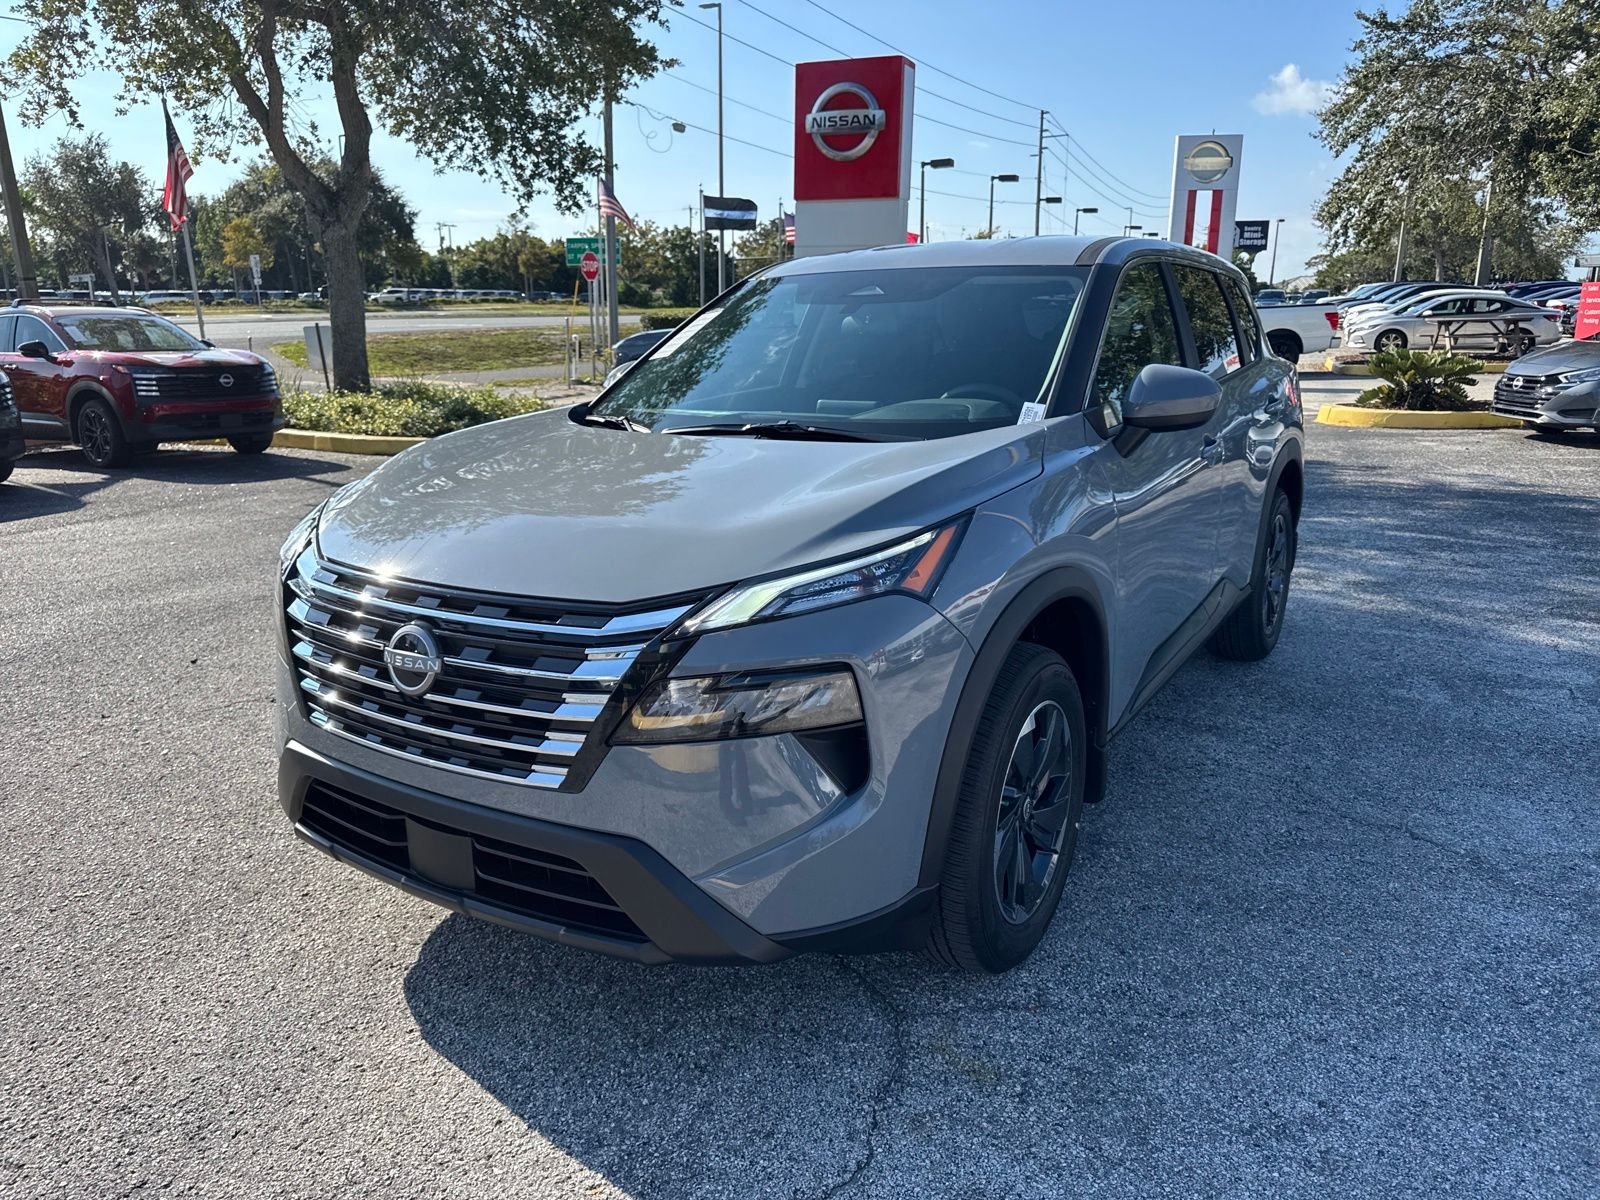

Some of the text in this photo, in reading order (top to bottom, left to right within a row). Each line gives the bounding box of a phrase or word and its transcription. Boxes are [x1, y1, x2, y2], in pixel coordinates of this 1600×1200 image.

[812, 114, 876, 128] NISSAN
[582, 261, 598, 271] STOP
[384, 650, 438, 670] NISSAN
